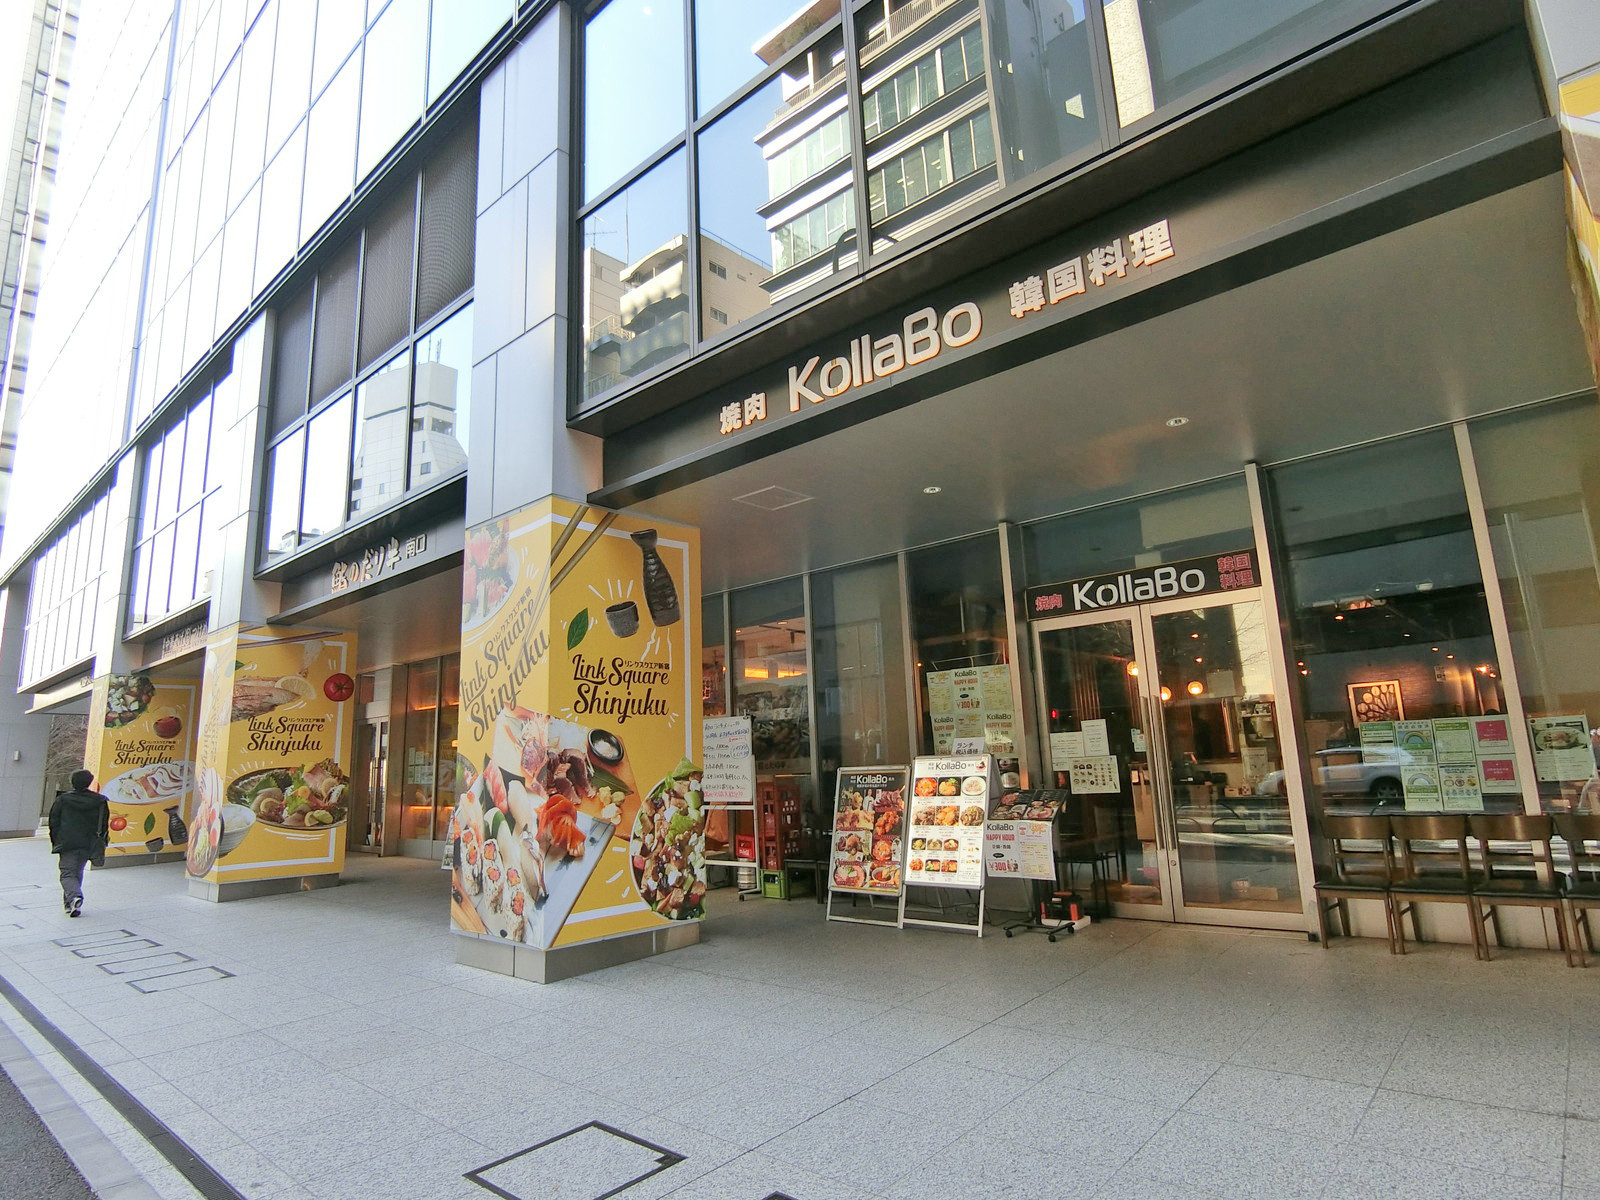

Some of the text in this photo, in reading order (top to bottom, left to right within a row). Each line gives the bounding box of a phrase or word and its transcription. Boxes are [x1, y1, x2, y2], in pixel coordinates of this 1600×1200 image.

[719, 218, 1175, 435] 焼肉 KollaBo 韓国料理
[405, 533, 428, 559] 南口
[1217, 552, 1251, 571] 韓国
[1035, 566, 1206, 611] 焼肉 KollaBo
[1219, 570, 1254, 589] 料理
[459, 598, 536, 714] Link Square
[624, 660, 670, 670] リンクスクエア新宿
[572, 653, 670, 691] Link Square
[573, 682, 669, 725] Shinjuku
[247, 716, 325, 736] Link Square
[114, 739, 176, 755] Link Square
[246, 732, 323, 757] Shinjuku
[114, 751, 175, 767] Shinjuku
[935, 761, 967, 771] KollaBo
[856, 774, 888, 785] KollaBo
[986, 823, 1014, 831] KollaBo
[989, 862, 1006, 871] ¥300
